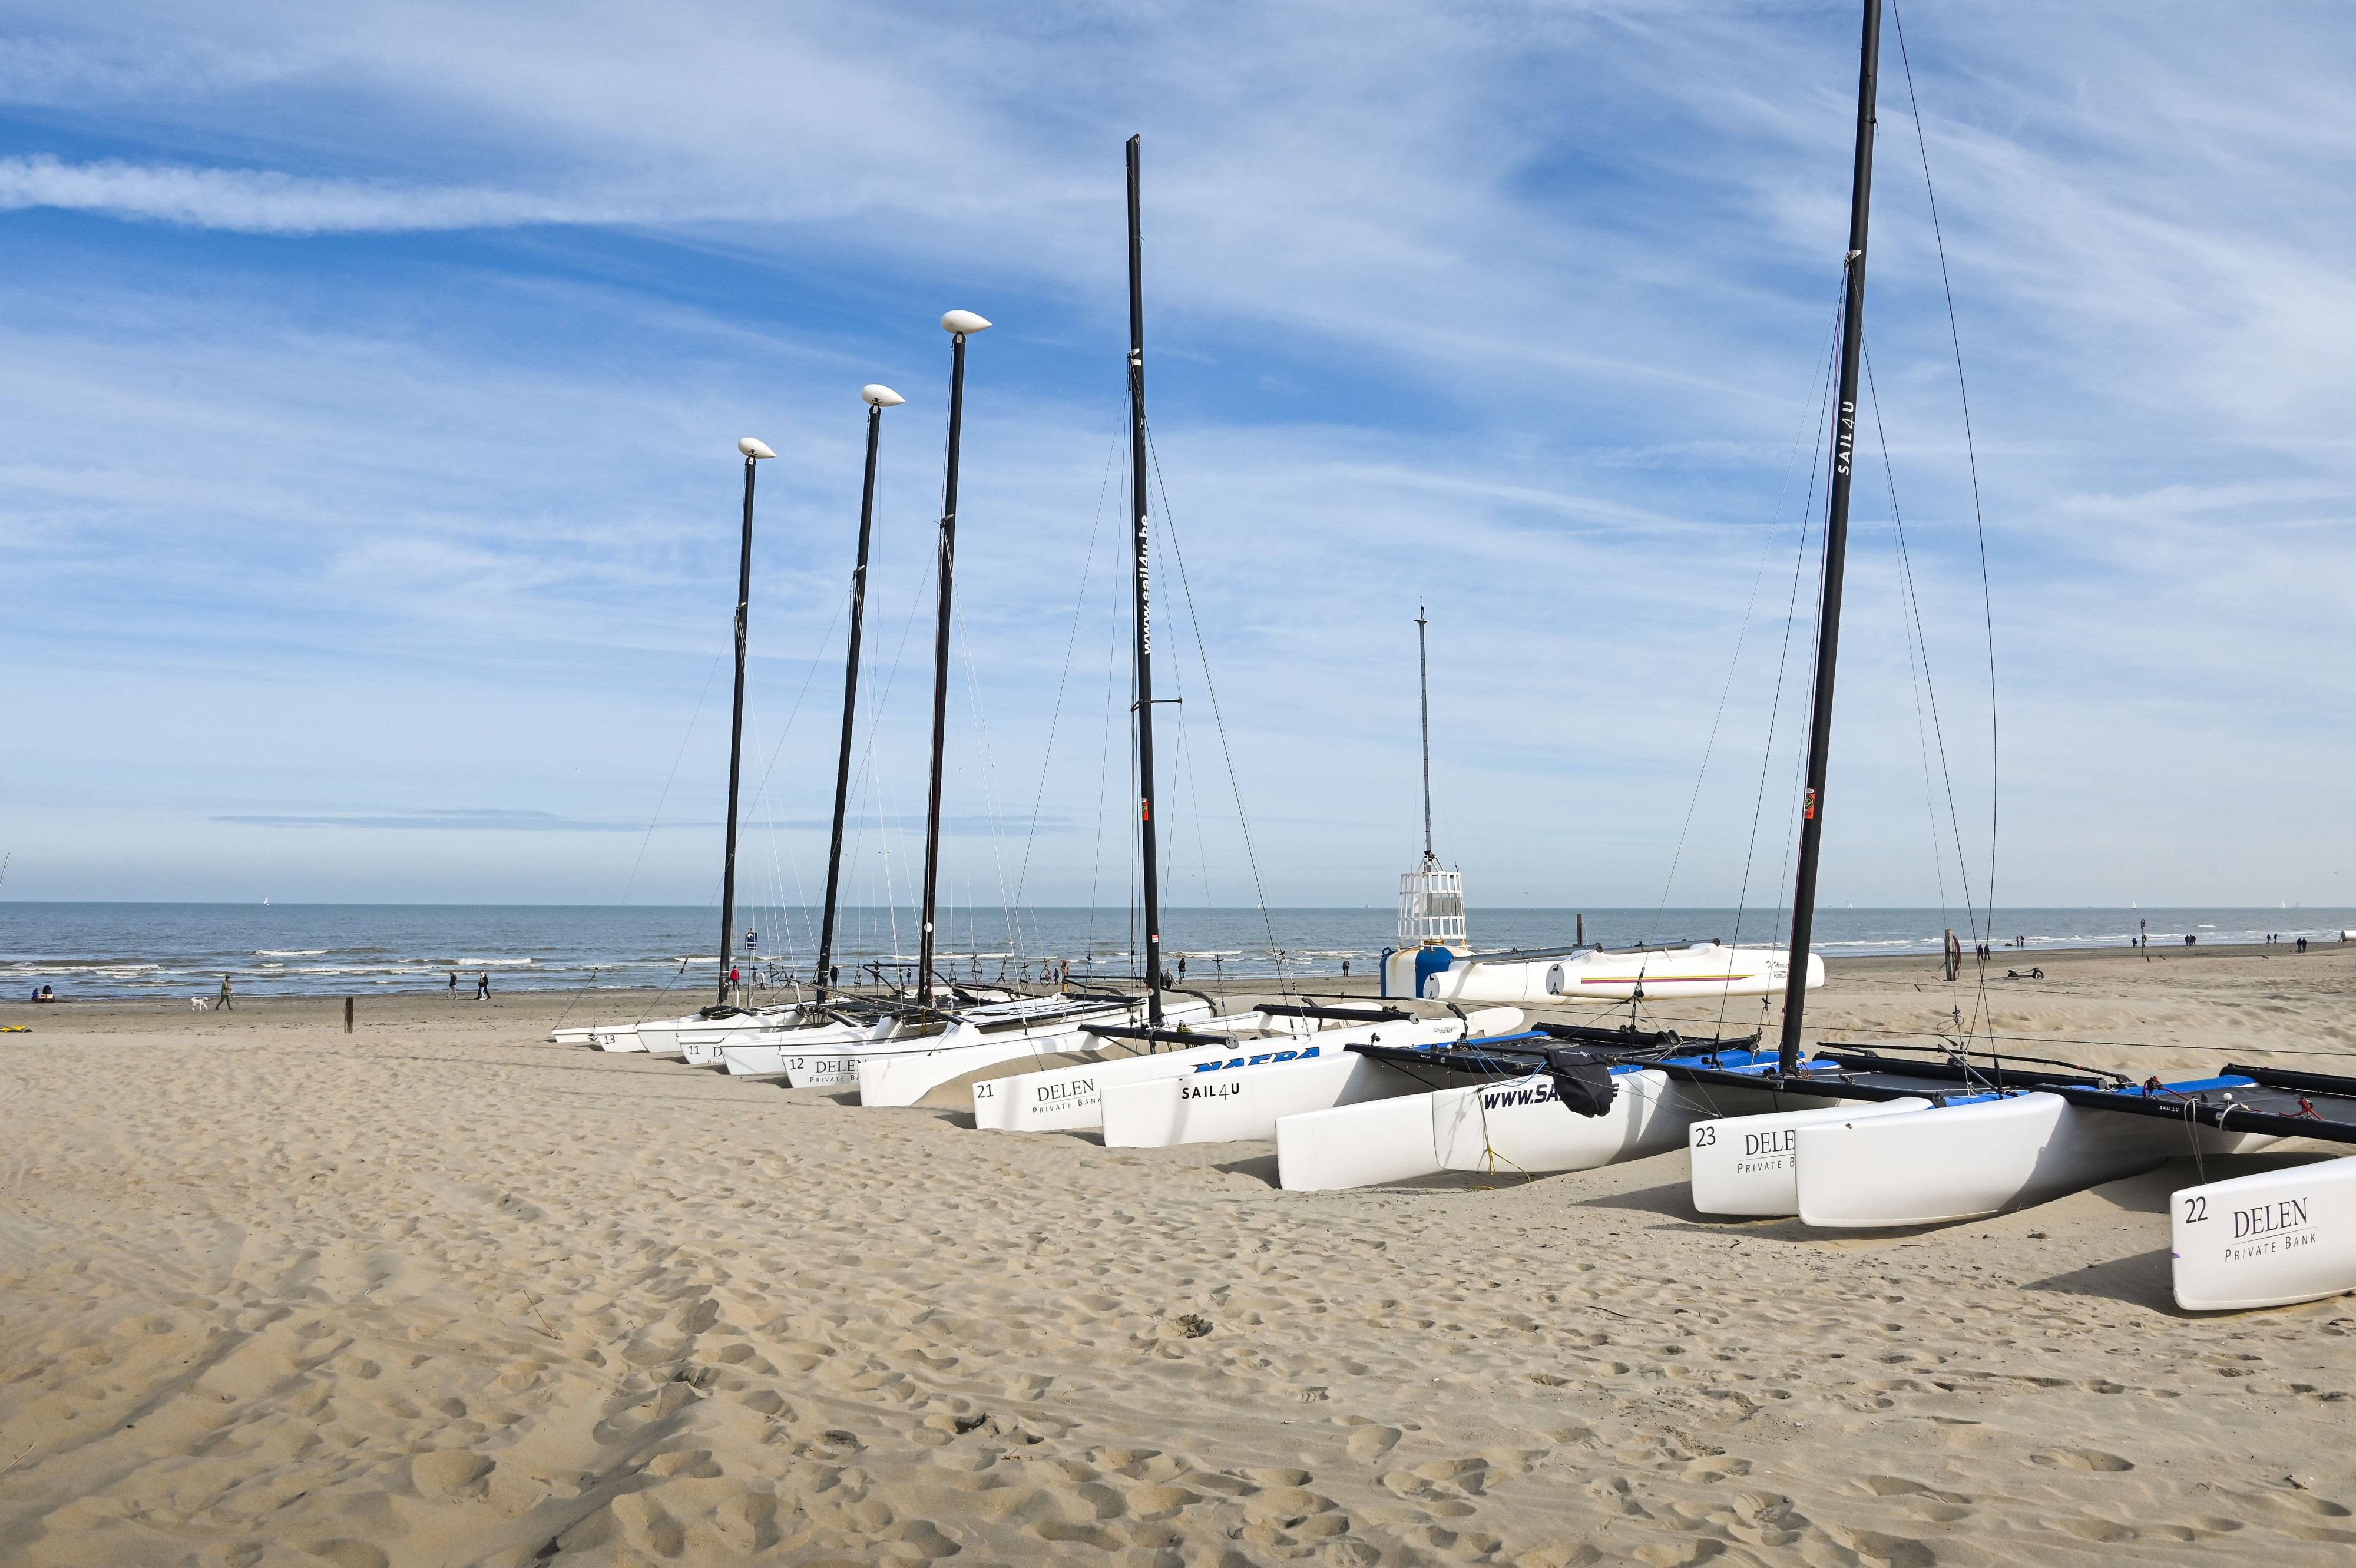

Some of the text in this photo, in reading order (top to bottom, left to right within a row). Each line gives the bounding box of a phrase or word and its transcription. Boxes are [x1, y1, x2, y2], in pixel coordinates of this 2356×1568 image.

[1838, 401, 1855, 476] SAIL4U
[604, 1035, 616, 1044] 13
[688, 1046, 700, 1055] 11
[789, 1058, 804, 1070] 12
[977, 1083, 994, 1098] 21
[1037, 1079, 1094, 1101] DELEN
[1182, 1083, 1239, 1101] SAIL4U
[1033, 1097, 1101, 1114] PRIVATE BANK
[1696, 1126, 1716, 1147] 23
[1745, 1130, 1795, 1156] DELE
[1738, 1160, 1782, 1173] PRIVATE
[2185, 1196, 2208, 1224] 22
[2232, 1197, 2308, 1238] DELEN
[2225, 1233, 2316, 1262] PRIVATE BANK
